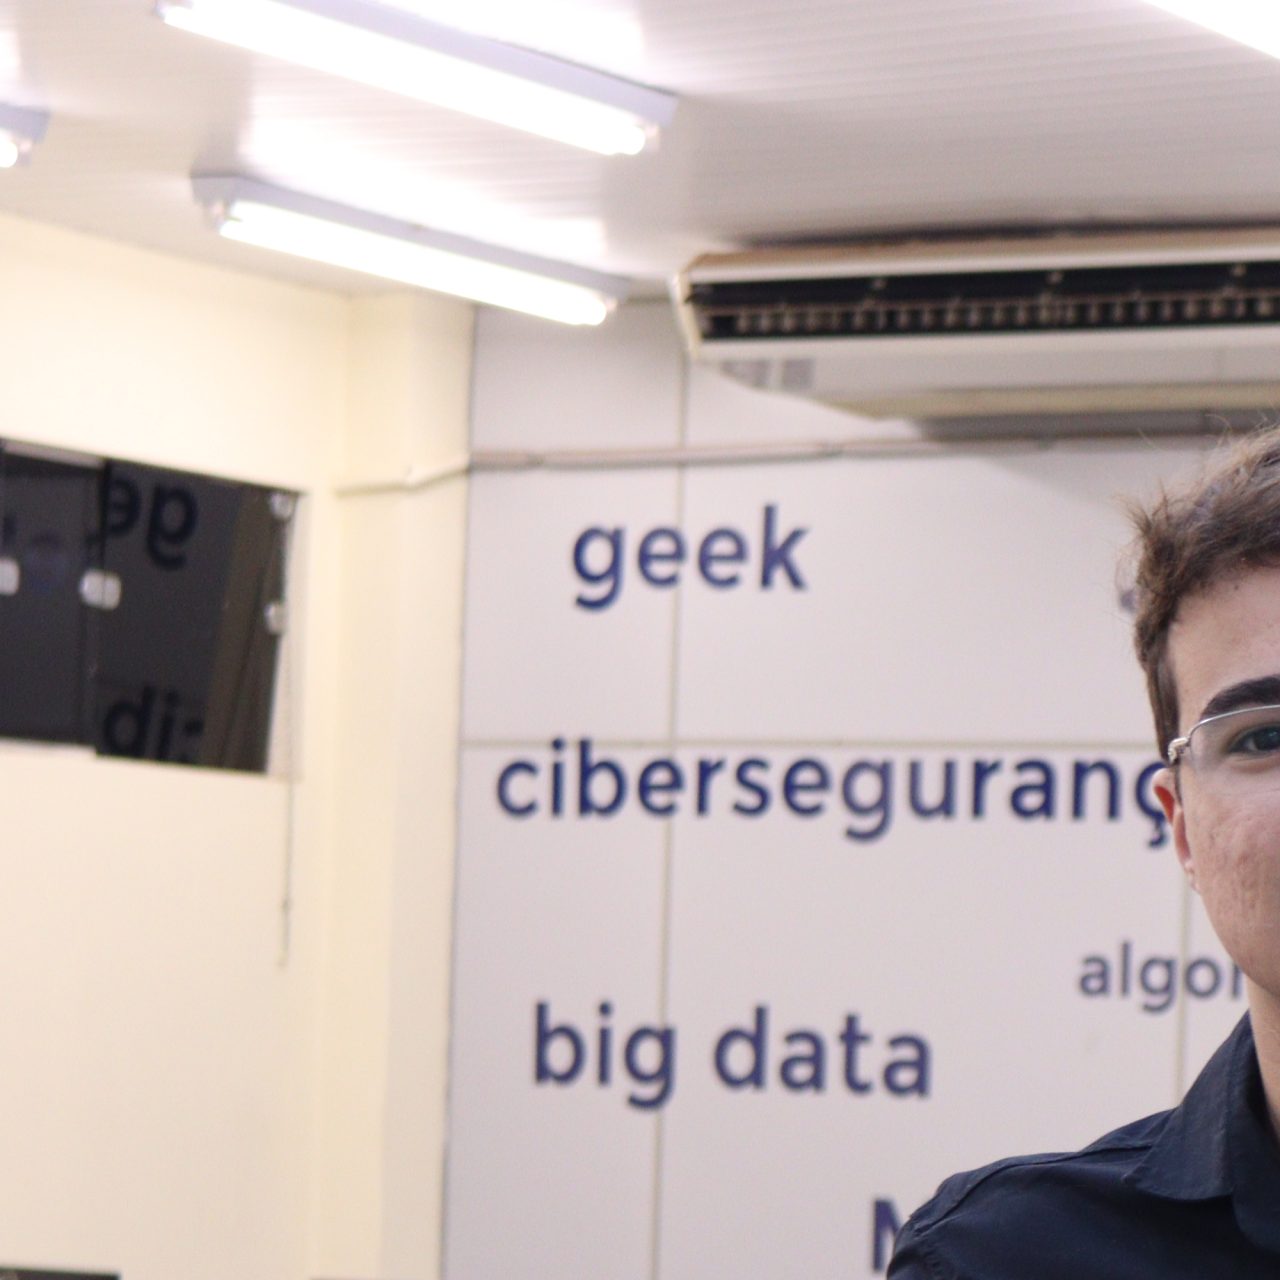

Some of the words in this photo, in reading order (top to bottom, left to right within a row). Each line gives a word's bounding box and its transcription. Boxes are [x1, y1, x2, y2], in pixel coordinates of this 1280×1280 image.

[571, 504, 809, 614] geek
[496, 737, 1167, 850] ciberseguranç
[534, 1001, 675, 1112] big
[713, 1005, 932, 1099] data
